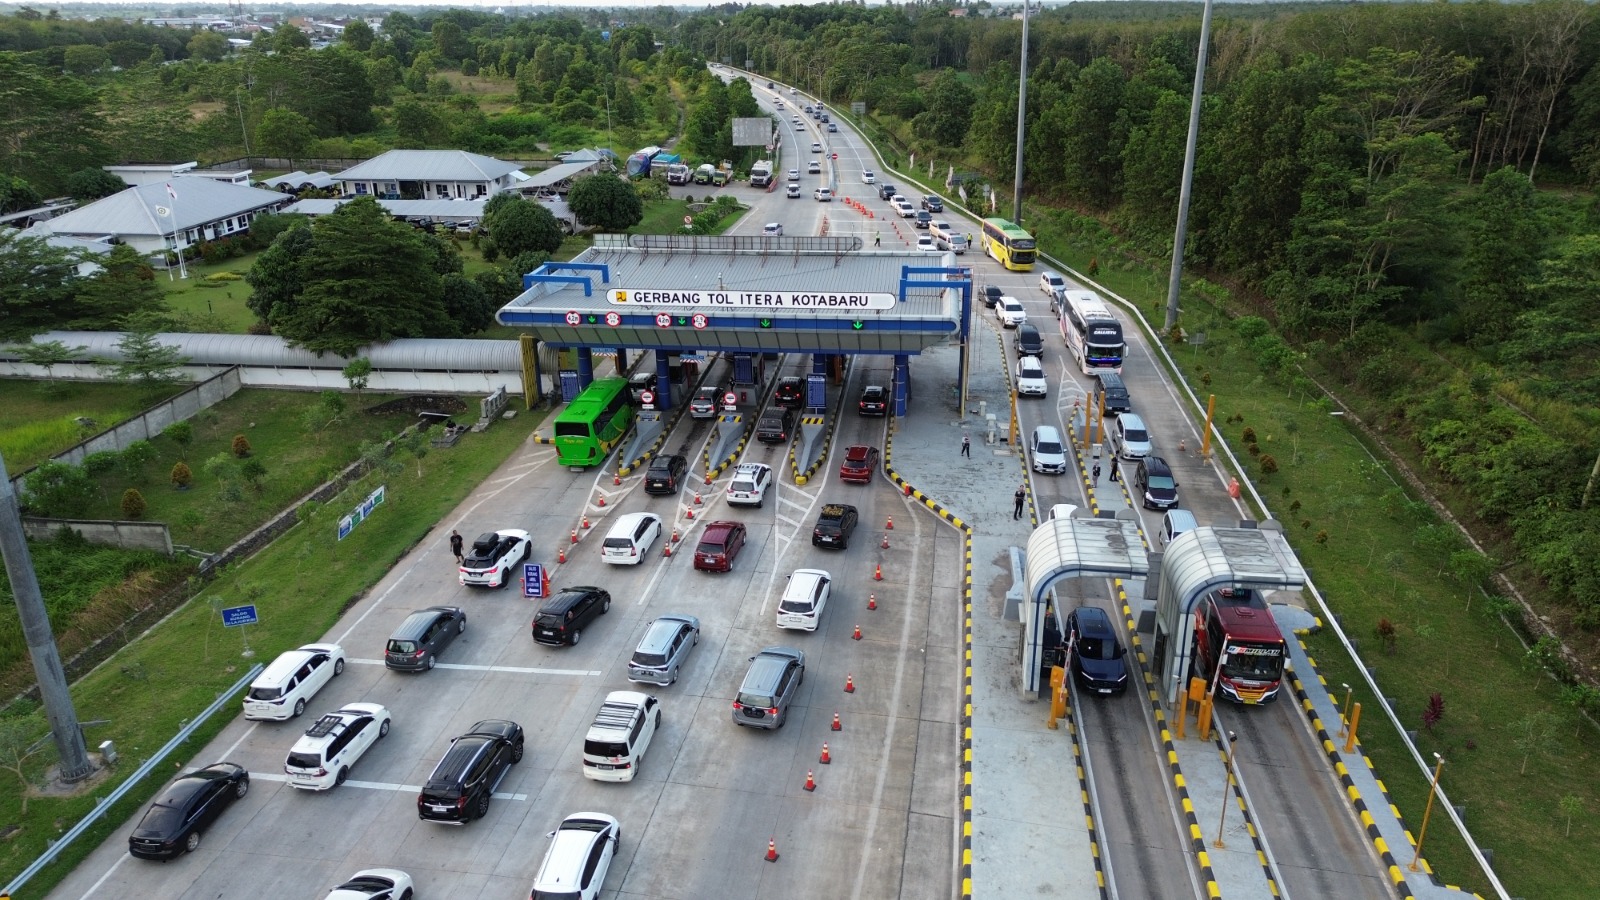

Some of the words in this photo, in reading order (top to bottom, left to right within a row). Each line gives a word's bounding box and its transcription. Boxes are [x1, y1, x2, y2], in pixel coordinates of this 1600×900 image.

[634, 291, 701, 304] GERBANG
[707, 293, 734, 305] TOL
[740, 294, 784, 306] ITERA
[792, 294, 869, 307] KOTABARU
